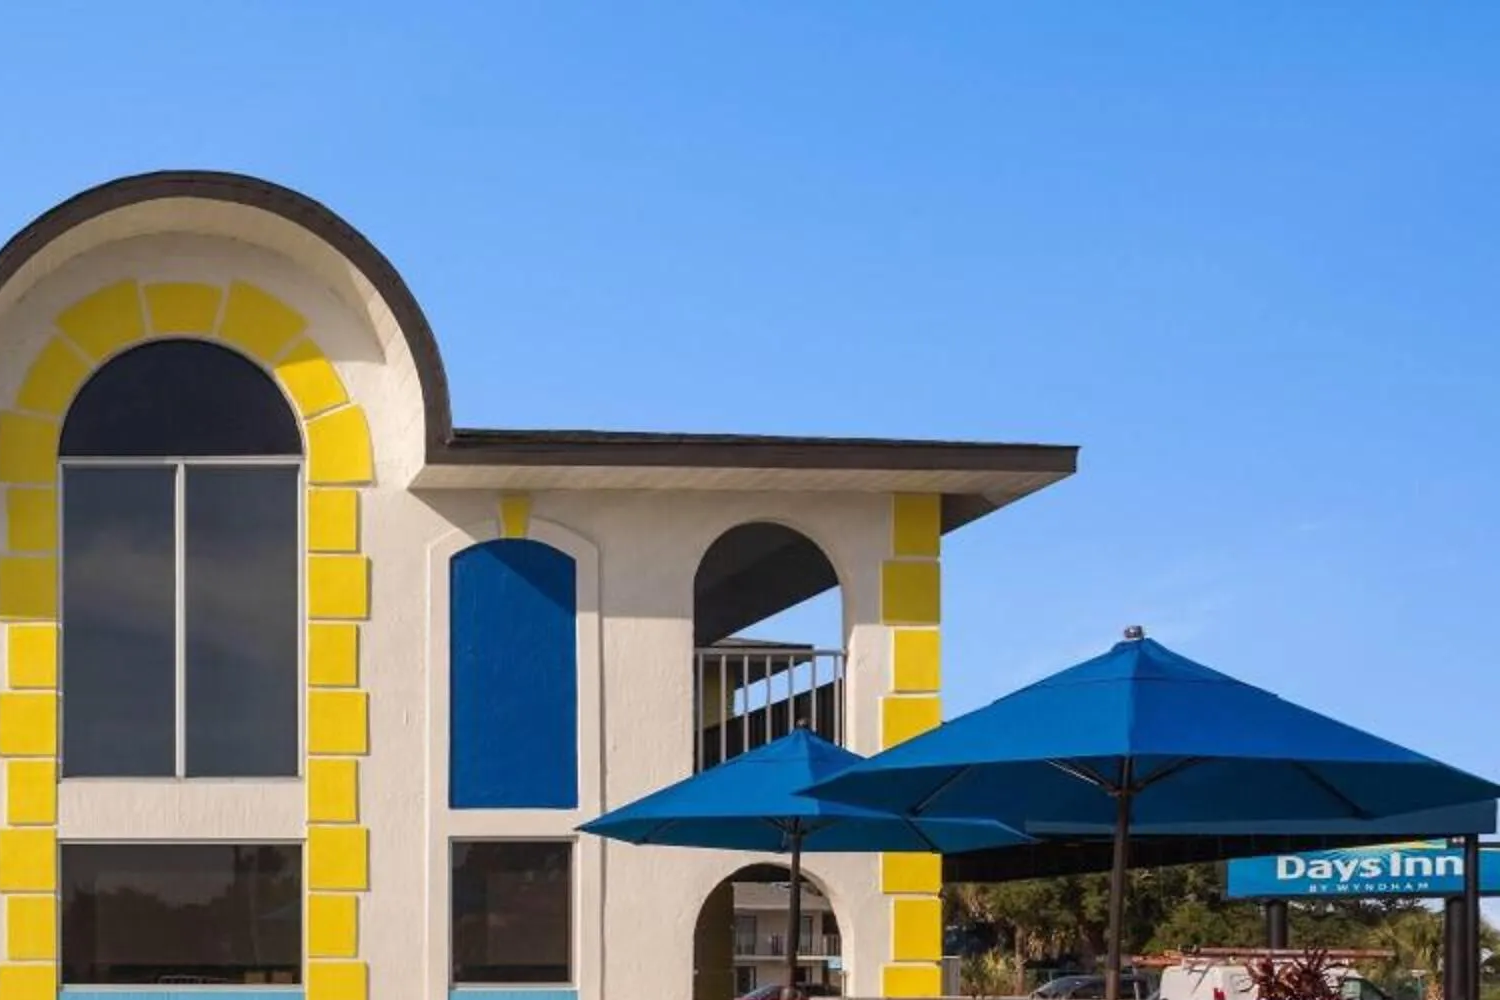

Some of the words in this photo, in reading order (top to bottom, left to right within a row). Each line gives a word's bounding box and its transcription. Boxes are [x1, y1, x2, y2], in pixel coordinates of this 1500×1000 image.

[1277, 855, 1382, 882] Days
[1390, 851, 1464, 877] Inn
[1309, 884, 1328, 893] BY
[1336, 882, 1429, 892] WYNDHAM
